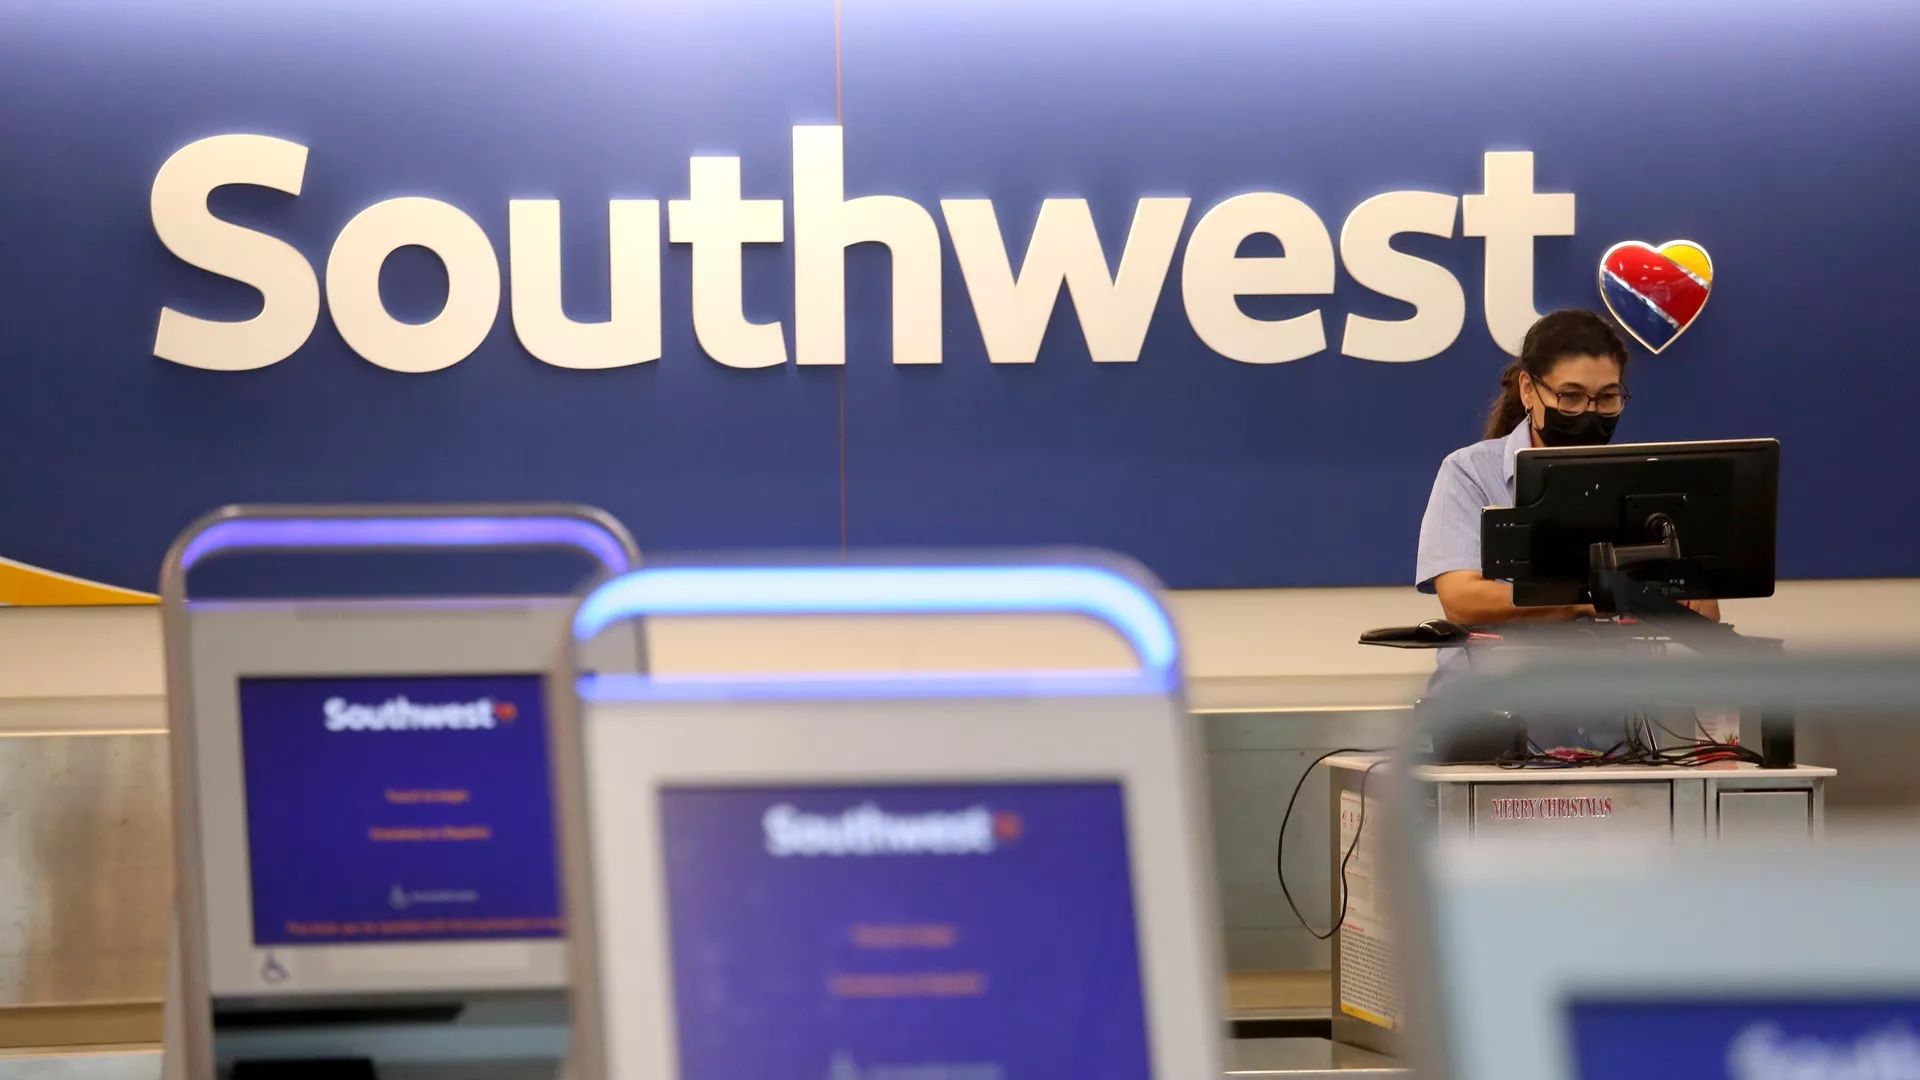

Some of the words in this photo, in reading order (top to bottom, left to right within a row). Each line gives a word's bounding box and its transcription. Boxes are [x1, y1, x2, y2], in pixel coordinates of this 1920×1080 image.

[151, 125, 1575, 373] Southwest
[323, 696, 496, 731] Southwest
[763, 802, 995, 856] Southwest
[1491, 798, 1538, 819] MERRY
[1540, 797, 1613, 818] CHRISTMAS
